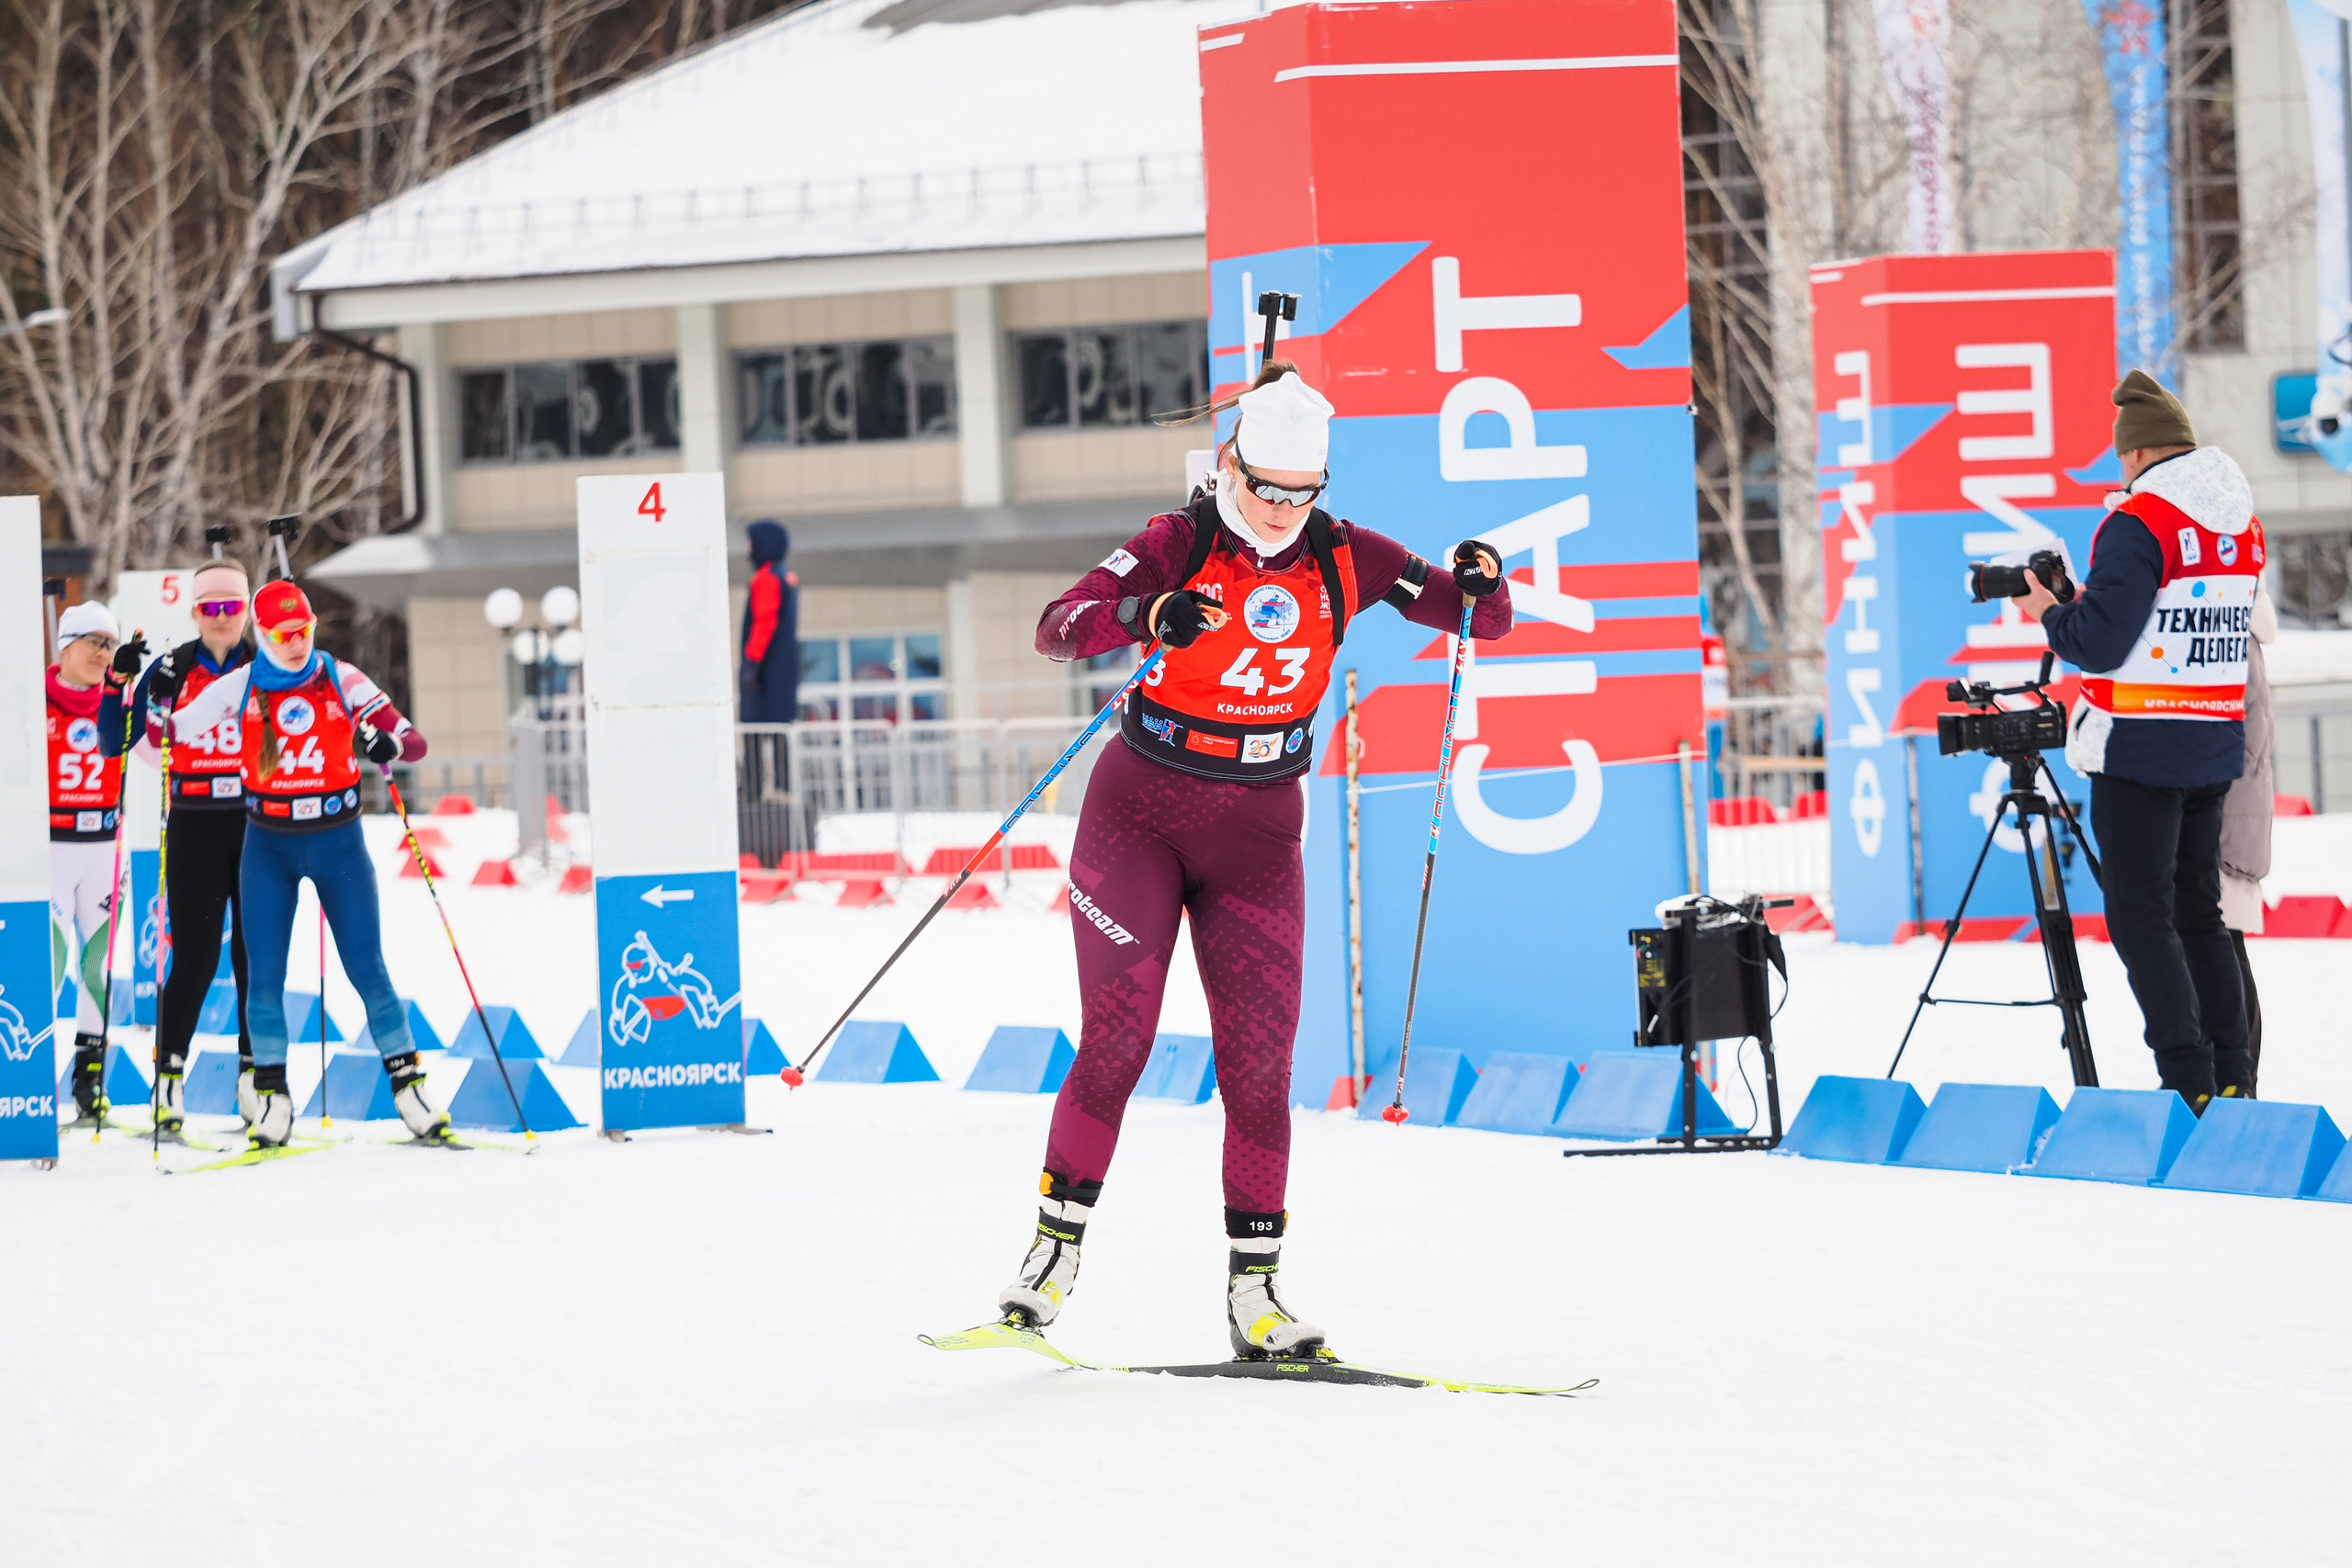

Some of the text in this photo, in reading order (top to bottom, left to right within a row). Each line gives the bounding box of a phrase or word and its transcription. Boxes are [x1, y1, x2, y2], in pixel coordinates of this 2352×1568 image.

[638, 482, 667, 523] 4
[1431, 256, 1603, 854] СТАРТ
[161, 575, 181, 604] 5
[1835, 351, 1885, 857] ФИНИШ
[1219, 647, 1311, 697] 43
[1216, 702, 1294, 716] КРАСНОЯРСК
[189, 718, 243, 755] 48
[59, 752, 105, 790] 52
[276, 736, 326, 776] 44
[271, 778, 325, 790] КРАСНОЯРСК
[604, 1061, 742, 1090] КРАСНОЯРСК
[1249, 1221, 1273, 1232] 193
[1276, 1363, 1310, 1373] FISCHER
